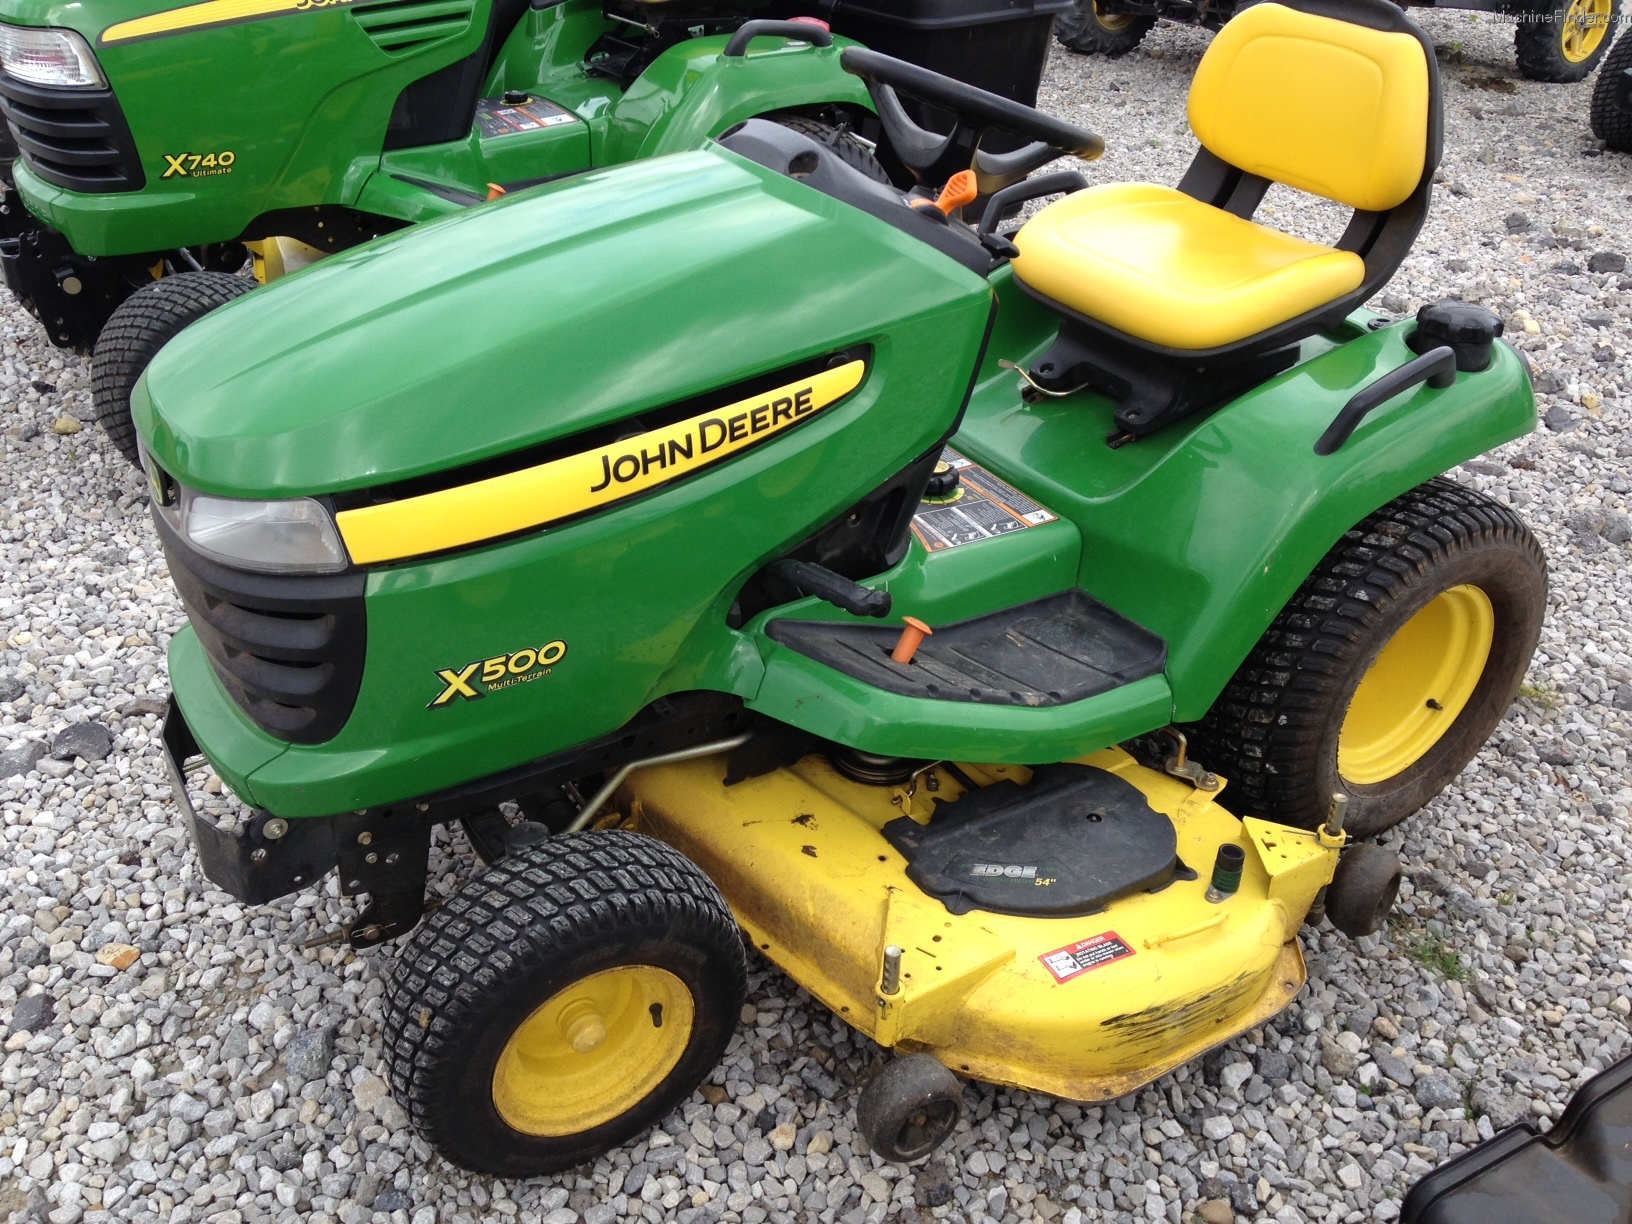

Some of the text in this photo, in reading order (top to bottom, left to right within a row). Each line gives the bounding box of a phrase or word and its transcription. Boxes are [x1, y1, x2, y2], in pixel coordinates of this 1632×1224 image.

[162, 151, 235, 178] X740
[193, 168, 232, 177] Ultimate
[590, 386, 813, 493] JOHN DEERE
[429, 639, 567, 708] X500
[487, 668, 552, 692] Multi-Terrain
[970, 863, 1037, 878] EDGE
[1034, 878, 1056, 886] 54"
[1081, 936, 1105, 948] DANGER
